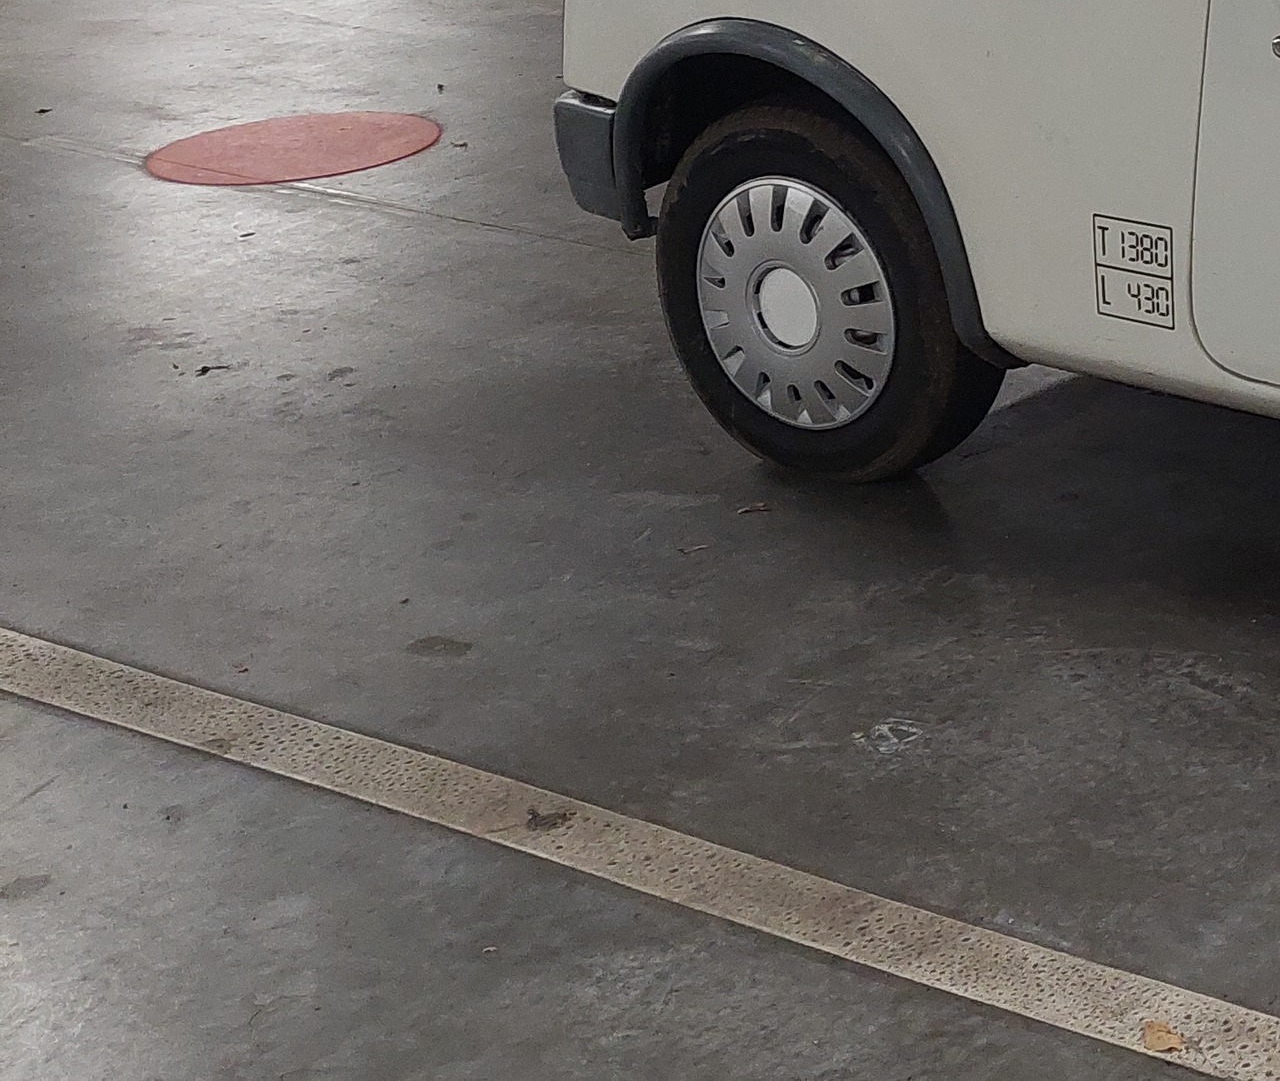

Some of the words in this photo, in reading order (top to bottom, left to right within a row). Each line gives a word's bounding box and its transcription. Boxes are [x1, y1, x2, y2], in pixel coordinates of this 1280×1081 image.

[1097, 225, 1110, 257] T
[1121, 230, 1169, 268] 1380
[1101, 274, 1112, 306] L
[1127, 282, 1170, 317] 430
